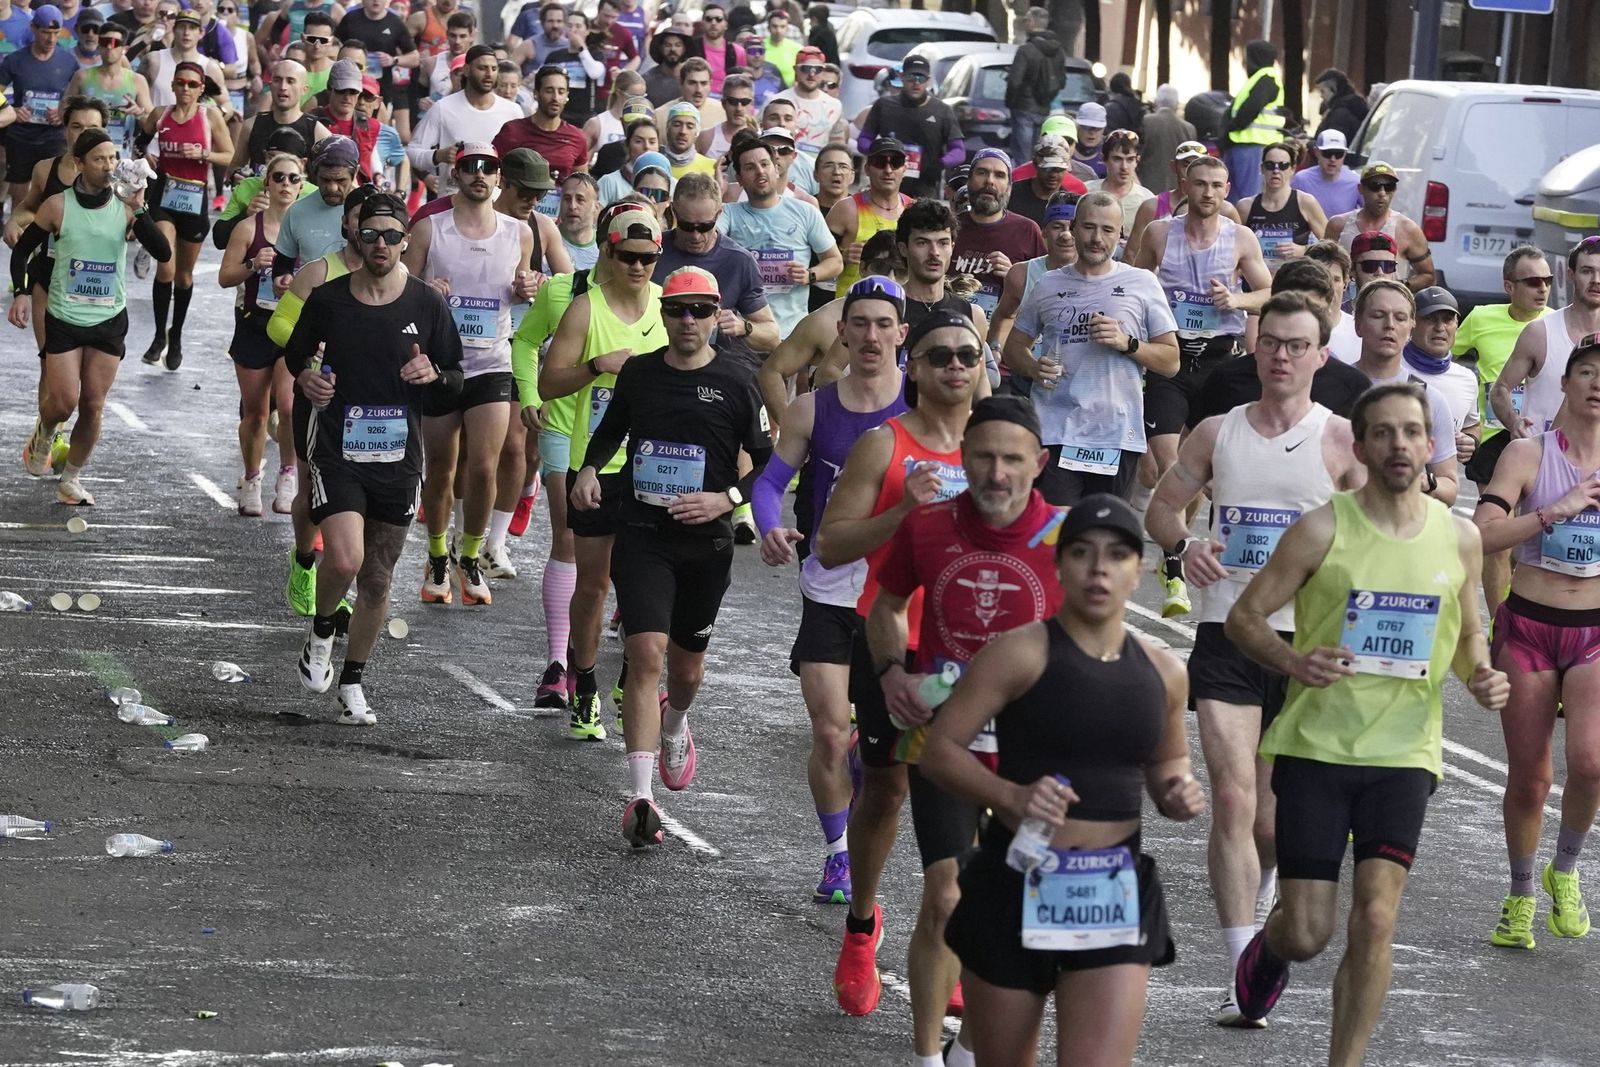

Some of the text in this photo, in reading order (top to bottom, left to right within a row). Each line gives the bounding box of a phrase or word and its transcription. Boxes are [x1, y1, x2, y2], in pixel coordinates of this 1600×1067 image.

[169, 201, 193, 212] ALICIA
[1472, 238, 1505, 250] 9177
[86, 263, 114, 271] ZURICH
[86, 276, 102, 284] 6405
[763, 275, 787, 284] RLOS
[75, 285, 110, 295] JUANLU
[464, 299, 495, 308] ZURICH
[463, 313, 480, 321] 6931
[459, 323, 484, 335] AIKO
[1186, 318, 1203, 329] TIM
[367, 408, 400, 417] ZURICH
[367, 426, 387, 434] 9262
[343, 439, 406, 450] JOÃO DIAS SMS
[658, 445, 697, 457] ZURICH
[1076, 448, 1105, 461] FRAN
[657, 465, 679, 475] 6217
[937, 466, 968, 480] ZURIC
[633, 480, 663, 491] VICTOR
[1245, 512, 1291, 524] ZURICH
[1573, 514, 1600, 525] ZURI
[1246, 534, 1269, 545] 8382
[1572, 534, 1595, 545] 7138
[1379, 595, 1431, 610] ZURICH
[1377, 620, 1405, 632] 6767
[1362, 636, 1414, 656] AITOR
[1066, 853, 1125, 871] ZURICH
[1037, 904, 1126, 925] CLAUDIA
